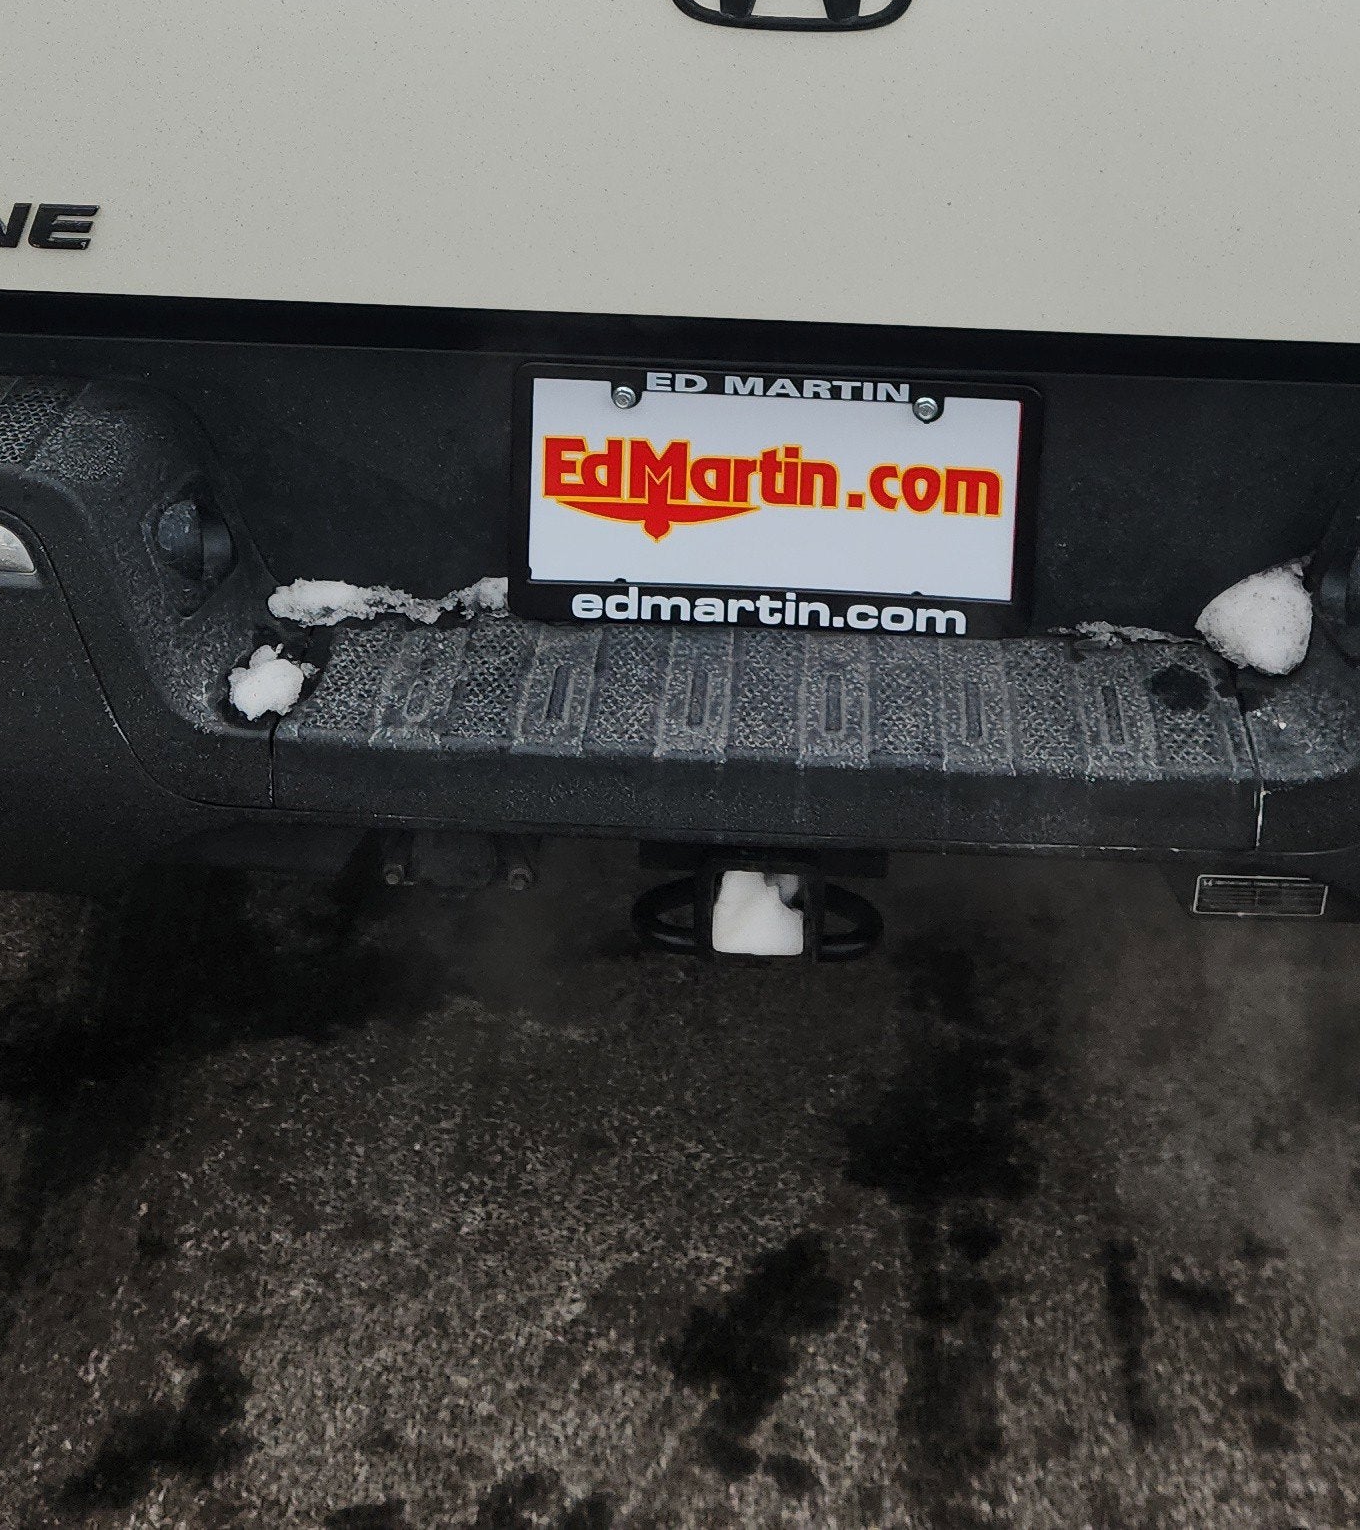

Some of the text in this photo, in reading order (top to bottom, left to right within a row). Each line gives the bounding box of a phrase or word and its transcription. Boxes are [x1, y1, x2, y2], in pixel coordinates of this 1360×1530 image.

[645, 371, 911, 403] ED MARTIN
[542, 433, 1004, 519] EdMartin.com
[570, 585, 968, 636] edmartin.com
